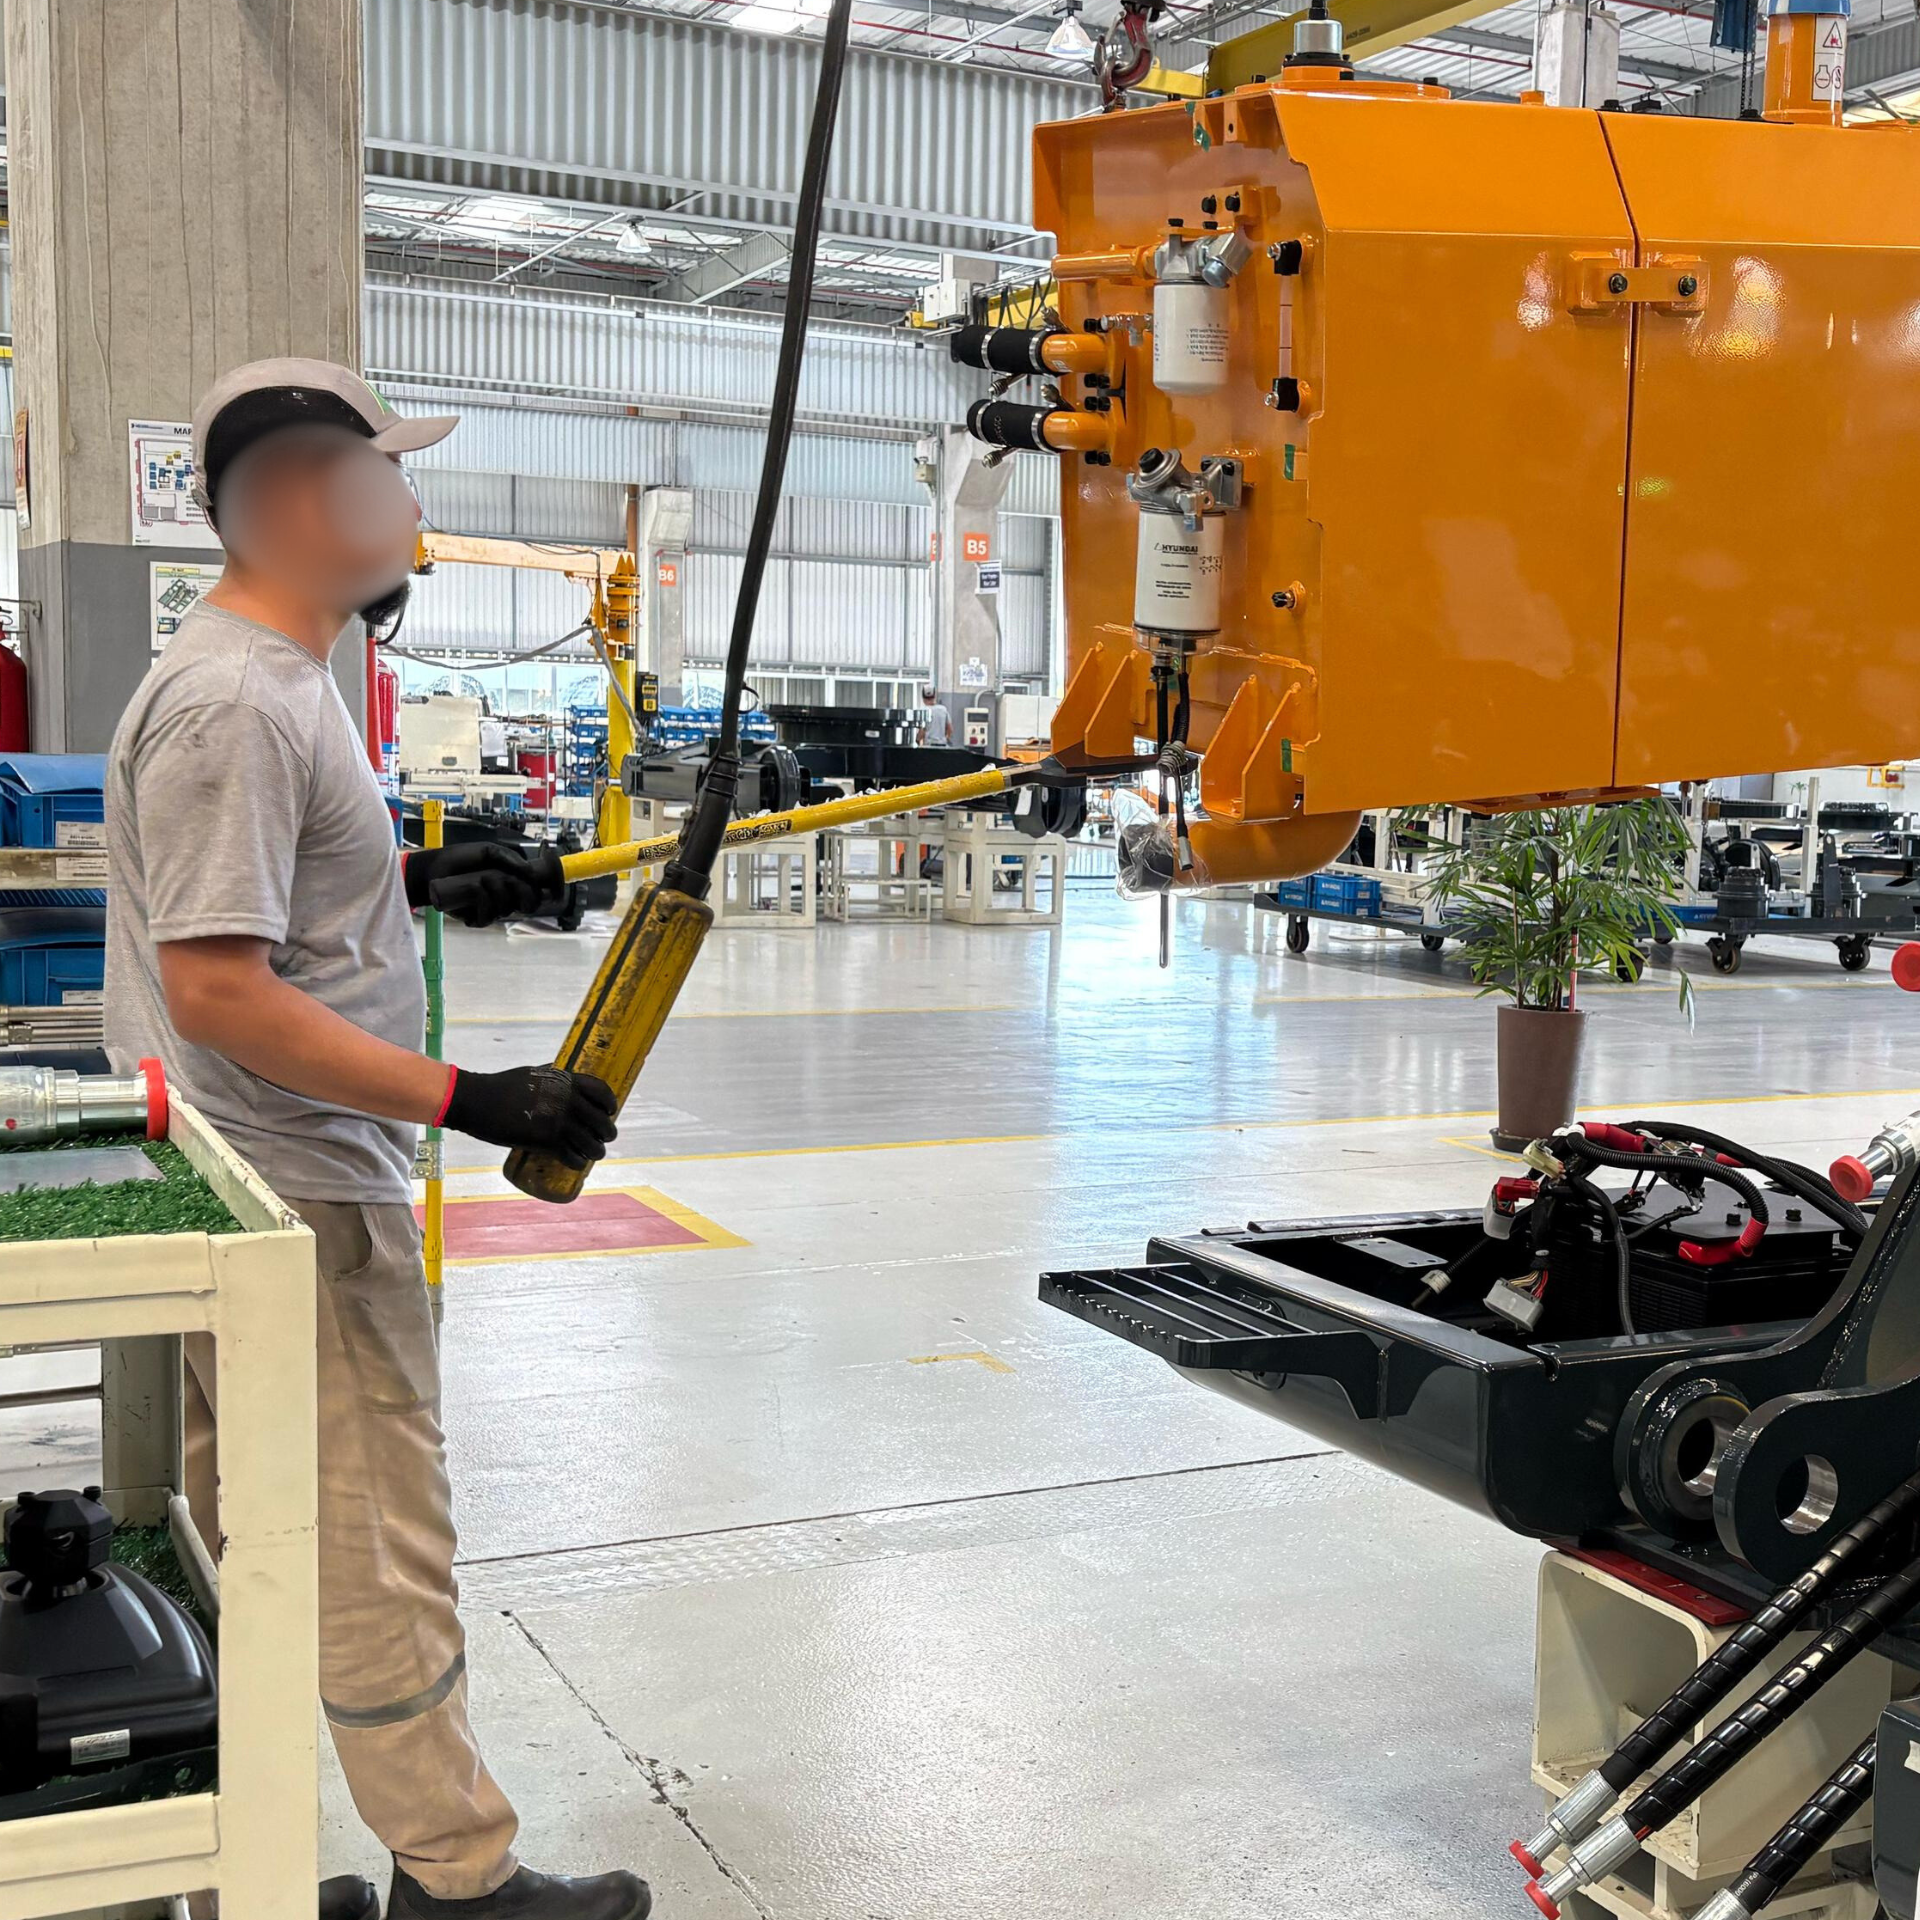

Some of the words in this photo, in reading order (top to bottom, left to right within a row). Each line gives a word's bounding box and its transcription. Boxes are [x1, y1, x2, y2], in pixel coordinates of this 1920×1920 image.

[967, 539, 987, 555] B5
[1162, 544, 1198, 553] HYUNDAI
[659, 569, 674, 581] B6
